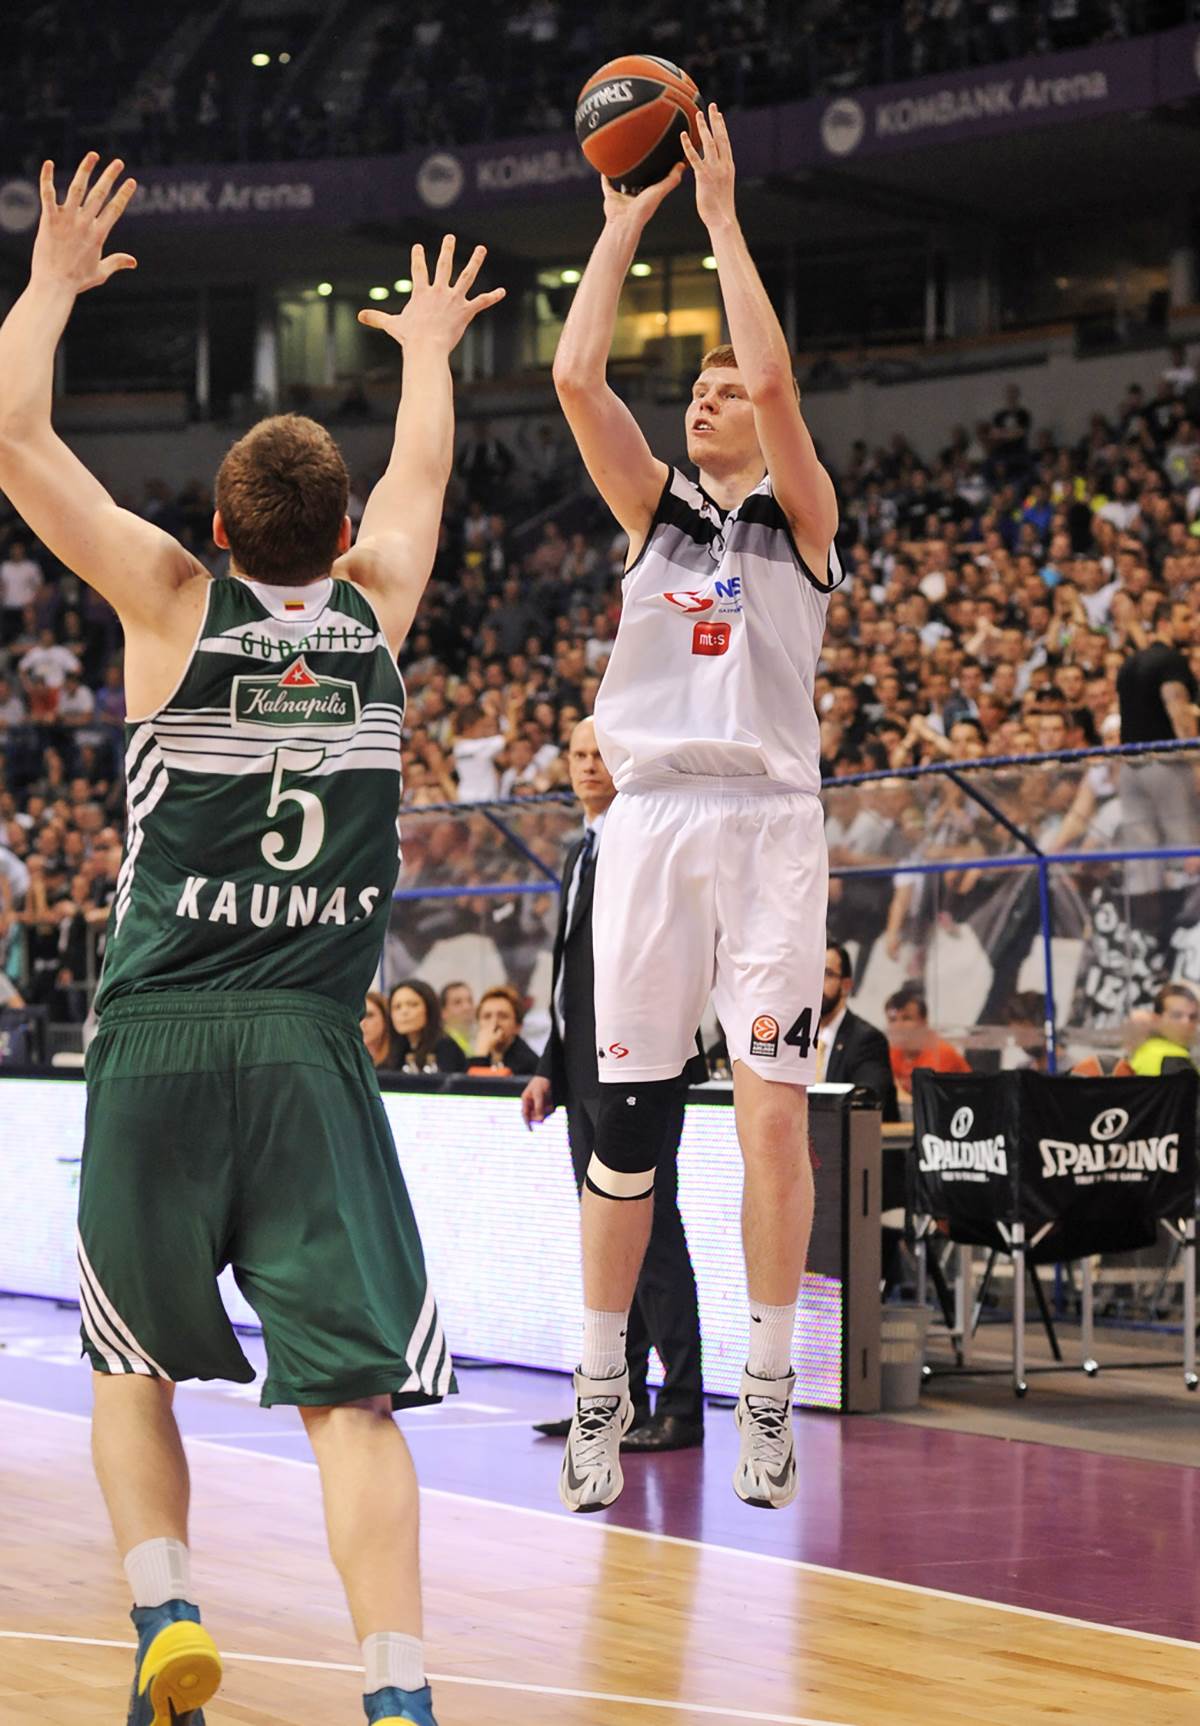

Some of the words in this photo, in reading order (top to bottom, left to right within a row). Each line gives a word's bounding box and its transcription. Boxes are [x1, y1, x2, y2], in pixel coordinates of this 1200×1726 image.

[575, 80, 634, 122] SPALDIN
[1018, 71, 1108, 109] Arena
[476, 152, 593, 189] KOMBA
[125, 183, 212, 215] BANK
[217, 181, 314, 212] Arena
[240, 626, 362, 659] GUDAITIS
[242, 687, 347, 720] Kalnapilis
[260, 746, 327, 872] 5
[175, 875, 380, 929] KAUNAS
[783, 1007, 820, 1059] 4
[919, 1133, 1008, 1176] SPALDING
[1038, 1132, 1180, 1179] SPALDING
